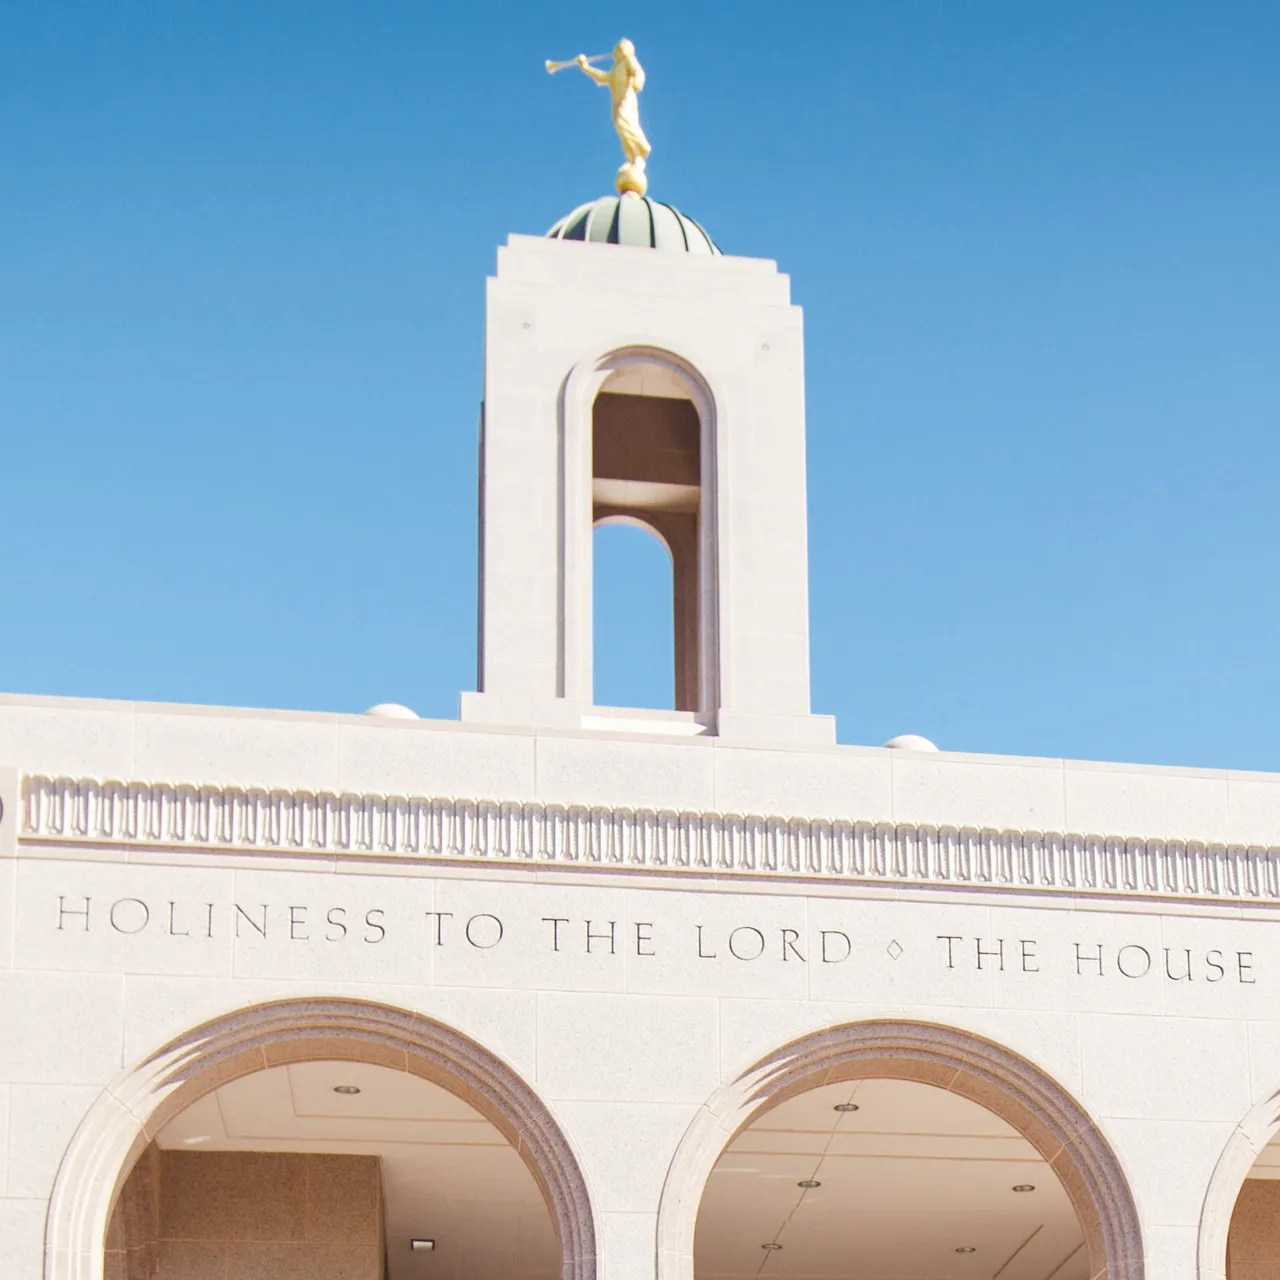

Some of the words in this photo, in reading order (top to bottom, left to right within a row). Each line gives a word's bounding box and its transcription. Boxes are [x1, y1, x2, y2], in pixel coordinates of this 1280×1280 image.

[56, 895, 387, 944] HOLINESS
[425, 911, 505, 950] TO
[541, 917, 657, 957] THE
[694, 924, 853, 965] LORD
[935, 935, 1041, 974] THE
[1072, 942, 1258, 985] HOUSE
